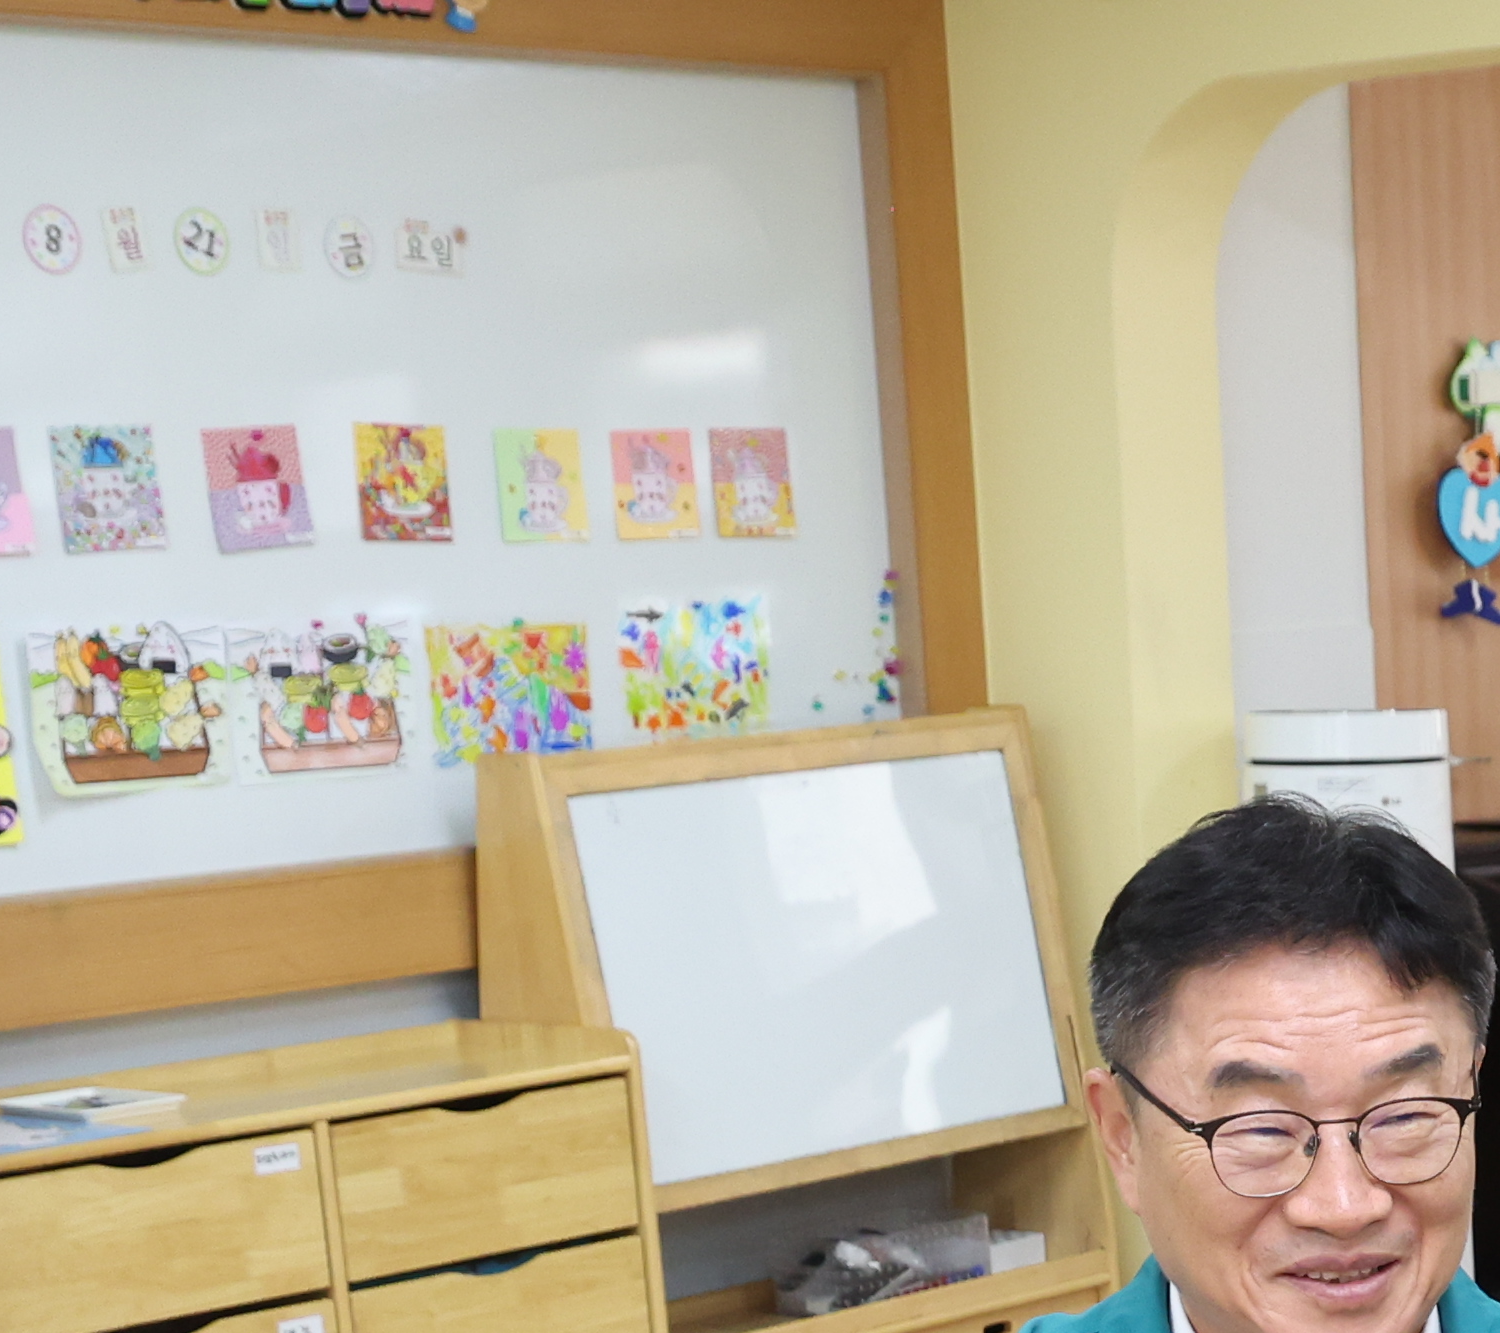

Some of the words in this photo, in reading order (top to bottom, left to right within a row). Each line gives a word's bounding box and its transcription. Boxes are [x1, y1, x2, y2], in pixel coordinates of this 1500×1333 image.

[44, 223, 63, 256] 8
[182, 219, 218, 260] 21
[339, 232, 365, 268] 금
[403, 234, 454, 267] 요일
